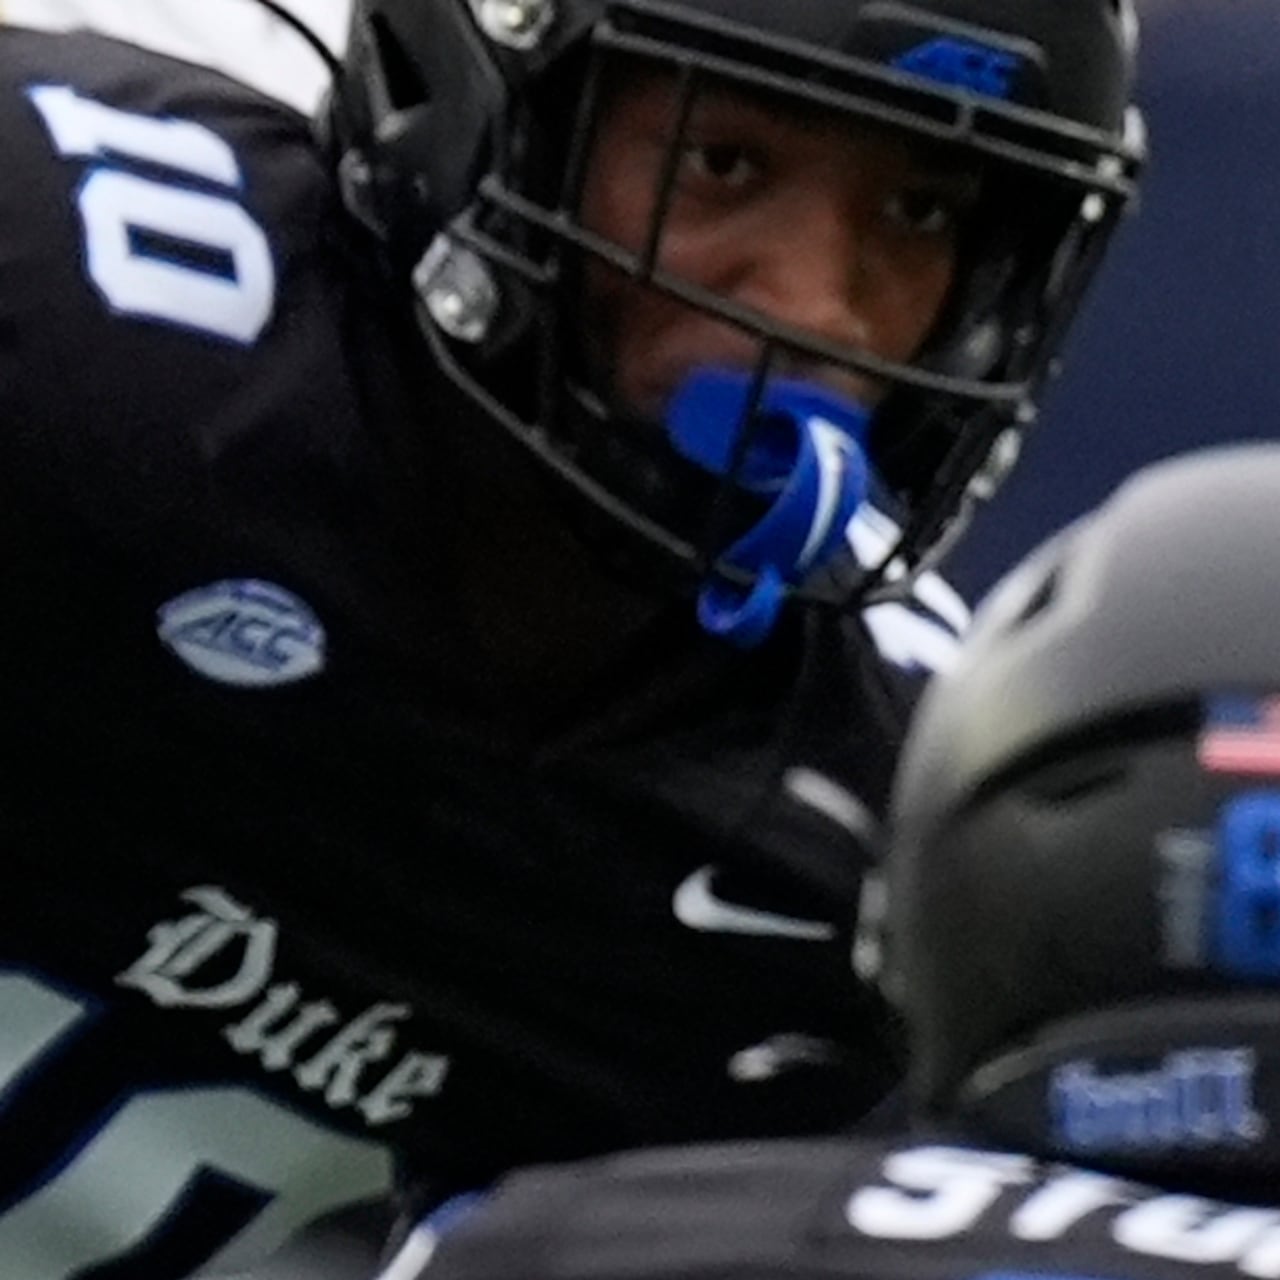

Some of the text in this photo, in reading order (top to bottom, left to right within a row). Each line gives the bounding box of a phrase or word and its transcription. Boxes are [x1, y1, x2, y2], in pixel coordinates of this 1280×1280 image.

[25, 82, 275, 345] 10
[168, 609, 310, 673] ACC
[114, 885, 450, 1126] Duke
